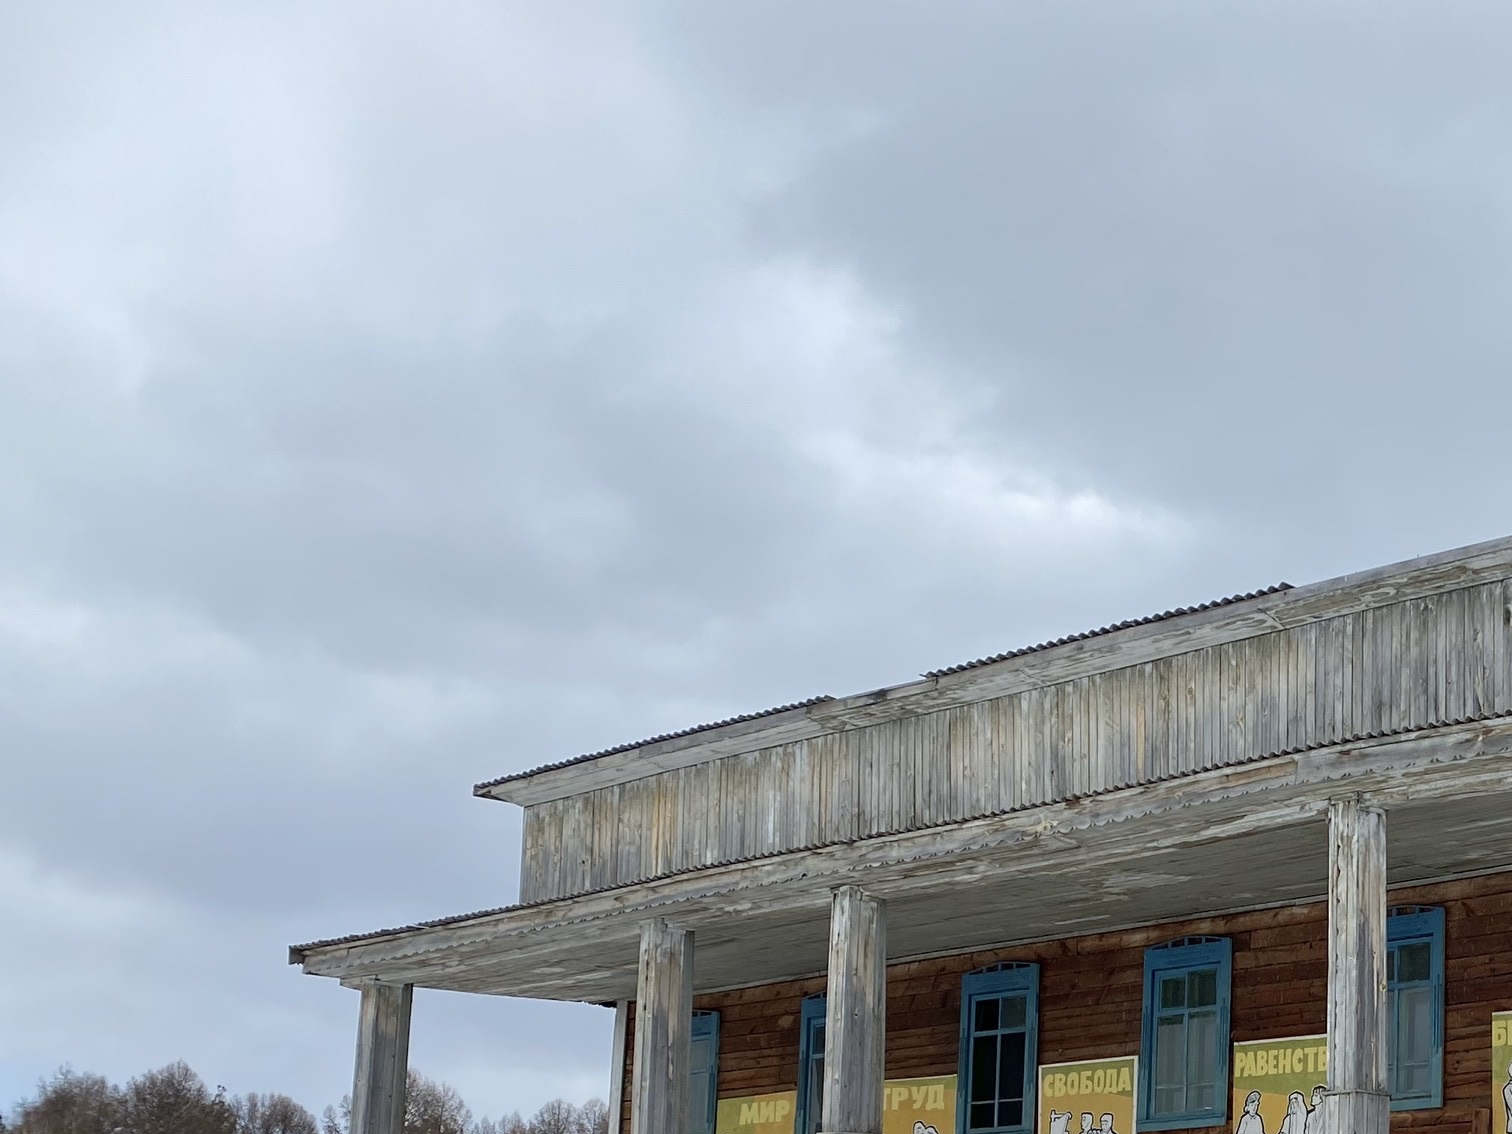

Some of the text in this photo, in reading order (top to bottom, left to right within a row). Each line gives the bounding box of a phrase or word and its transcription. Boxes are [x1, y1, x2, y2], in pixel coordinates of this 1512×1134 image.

[1234, 1046, 1327, 1077] РАВЕНСТВ
[1043, 1067, 1131, 1098] СВОБОДА
[738, 1100, 790, 1126] МИР
